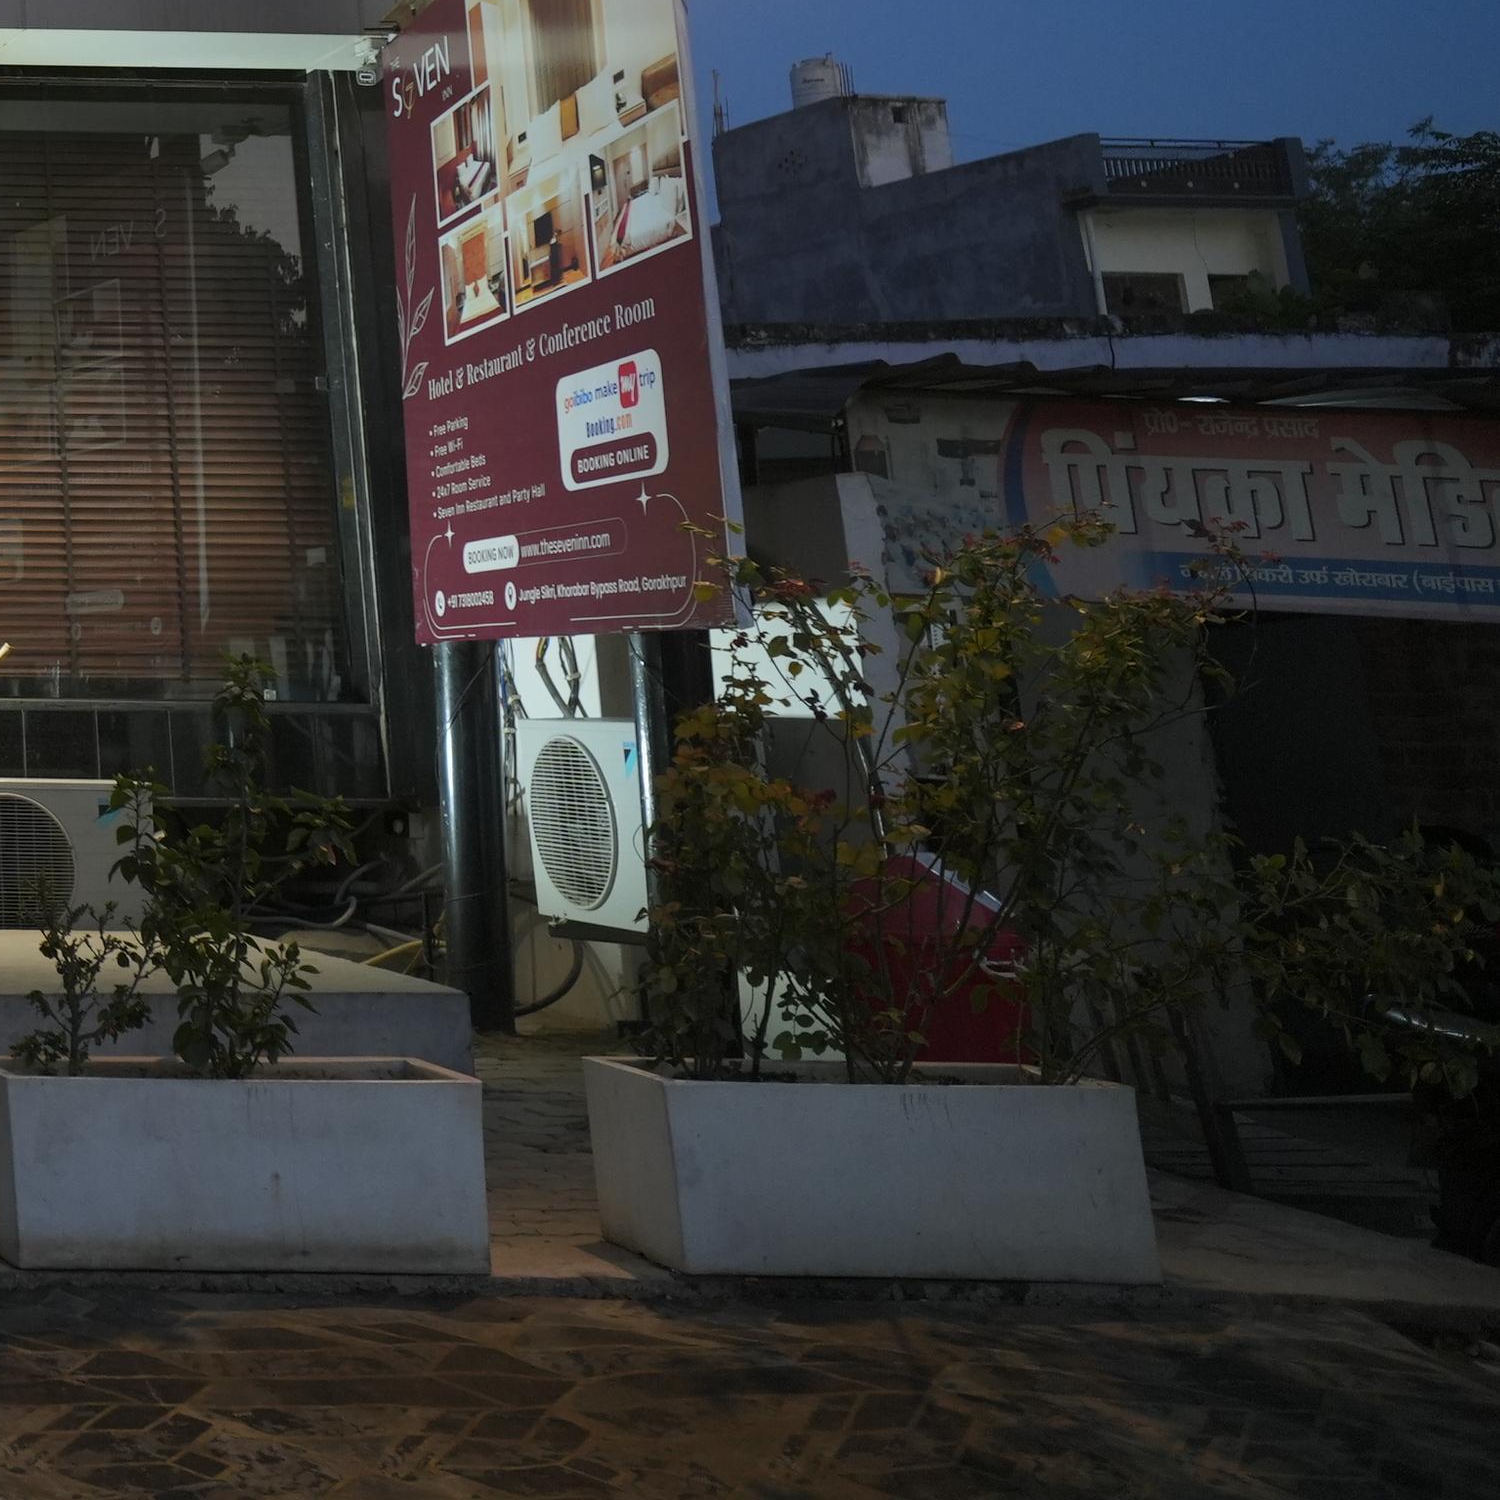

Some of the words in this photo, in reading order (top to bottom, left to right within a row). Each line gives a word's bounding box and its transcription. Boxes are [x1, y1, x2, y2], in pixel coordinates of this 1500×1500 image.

[428, 369, 453, 401] Hotel
[455, 366, 464, 390] &
[466, 344, 524, 386] Restaurant
[526, 337, 536, 362] &
[538, 314, 612, 357] Conference
[613, 298, 656, 331] Room
[595, 380, 618, 400] make
[639, 367, 656, 389] trip
[576, 451, 615, 473] BOOKING
[616, 444, 650, 465] ONLINE
[468, 548, 497, 565] BOOKING
